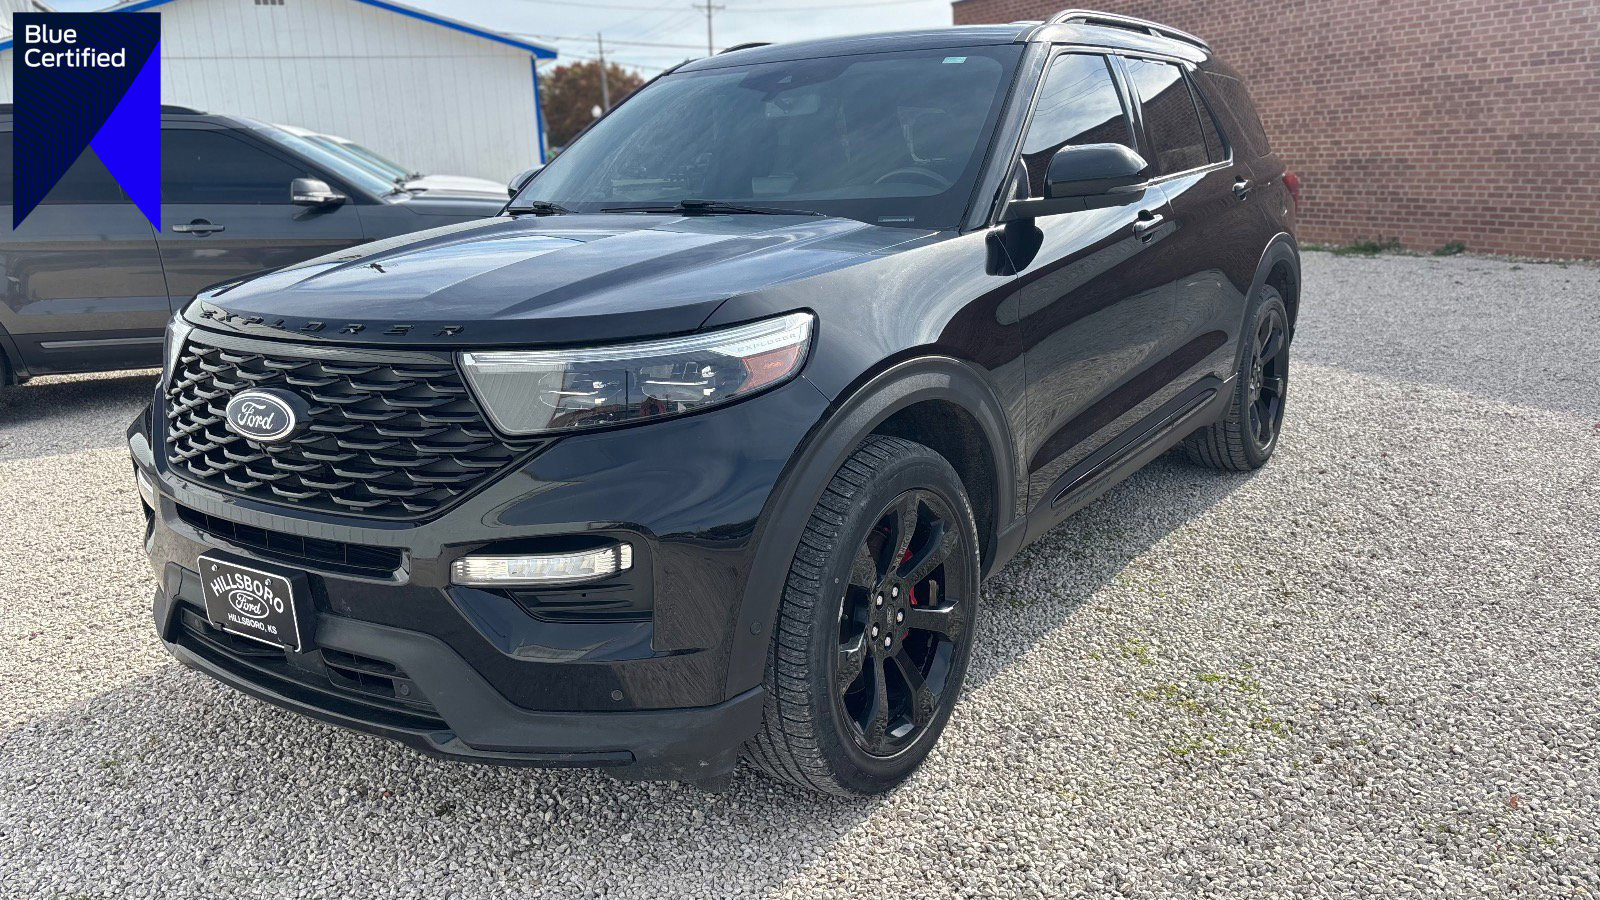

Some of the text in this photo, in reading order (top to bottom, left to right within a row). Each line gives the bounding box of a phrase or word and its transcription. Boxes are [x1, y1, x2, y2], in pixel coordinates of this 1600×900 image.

[200, 310, 464, 336] EXPLORER
[237, 401, 275, 430] Ford
[210, 573, 284, 613] HILLSBORO
[235, 593, 261, 615] Ford
[227, 613, 277, 634] HILLSBORO, KS
